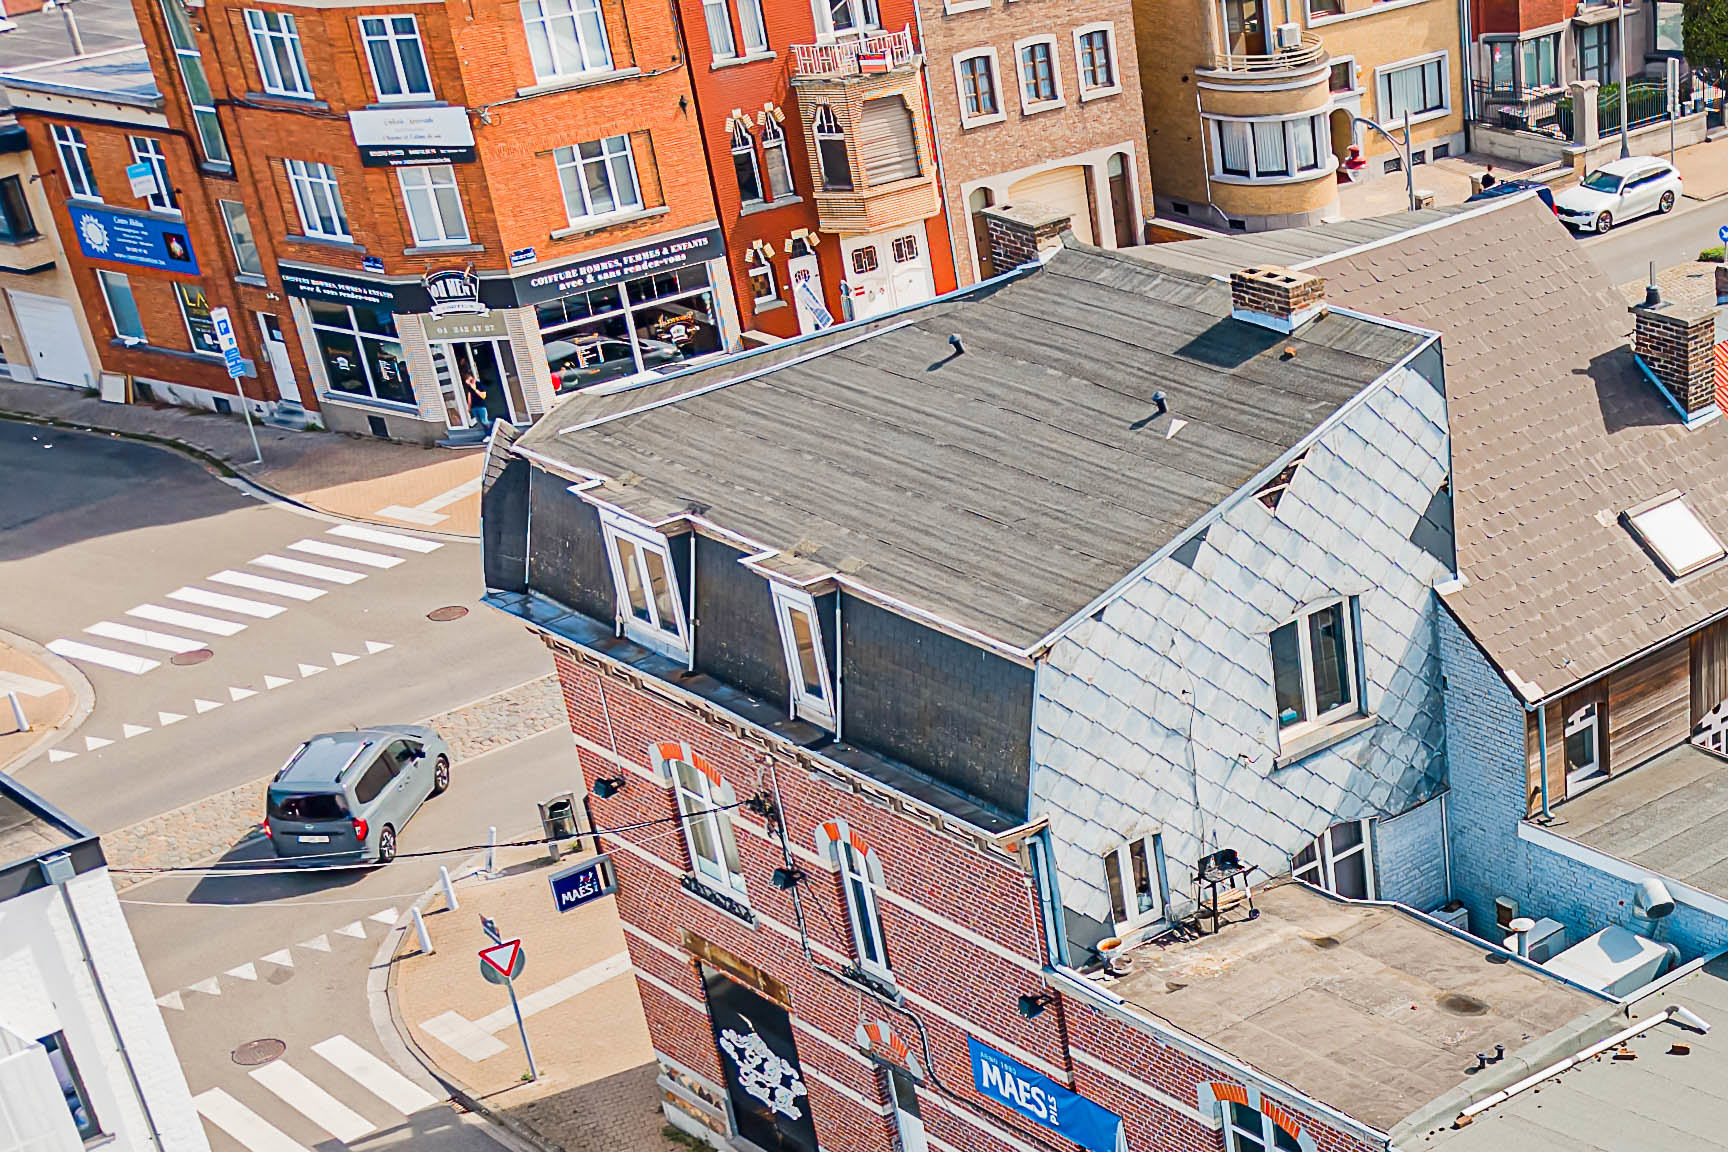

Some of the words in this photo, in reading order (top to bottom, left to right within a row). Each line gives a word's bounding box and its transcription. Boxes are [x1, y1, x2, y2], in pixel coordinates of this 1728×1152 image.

[530, 269, 579, 288] COIFFURE
[622, 248, 661, 265] FEMMES
[662, 246, 670, 256] &
[670, 236, 709, 253] ENFANTS
[558, 278, 584, 291] avec
[585, 273, 596, 284] &
[597, 268, 622, 281] sans
[623, 253, 687, 276] rendez-vous
[561, 884, 594, 905] MAES
[981, 1059, 1048, 1119] MAES
[1047, 1094, 1060, 1126] PILS
